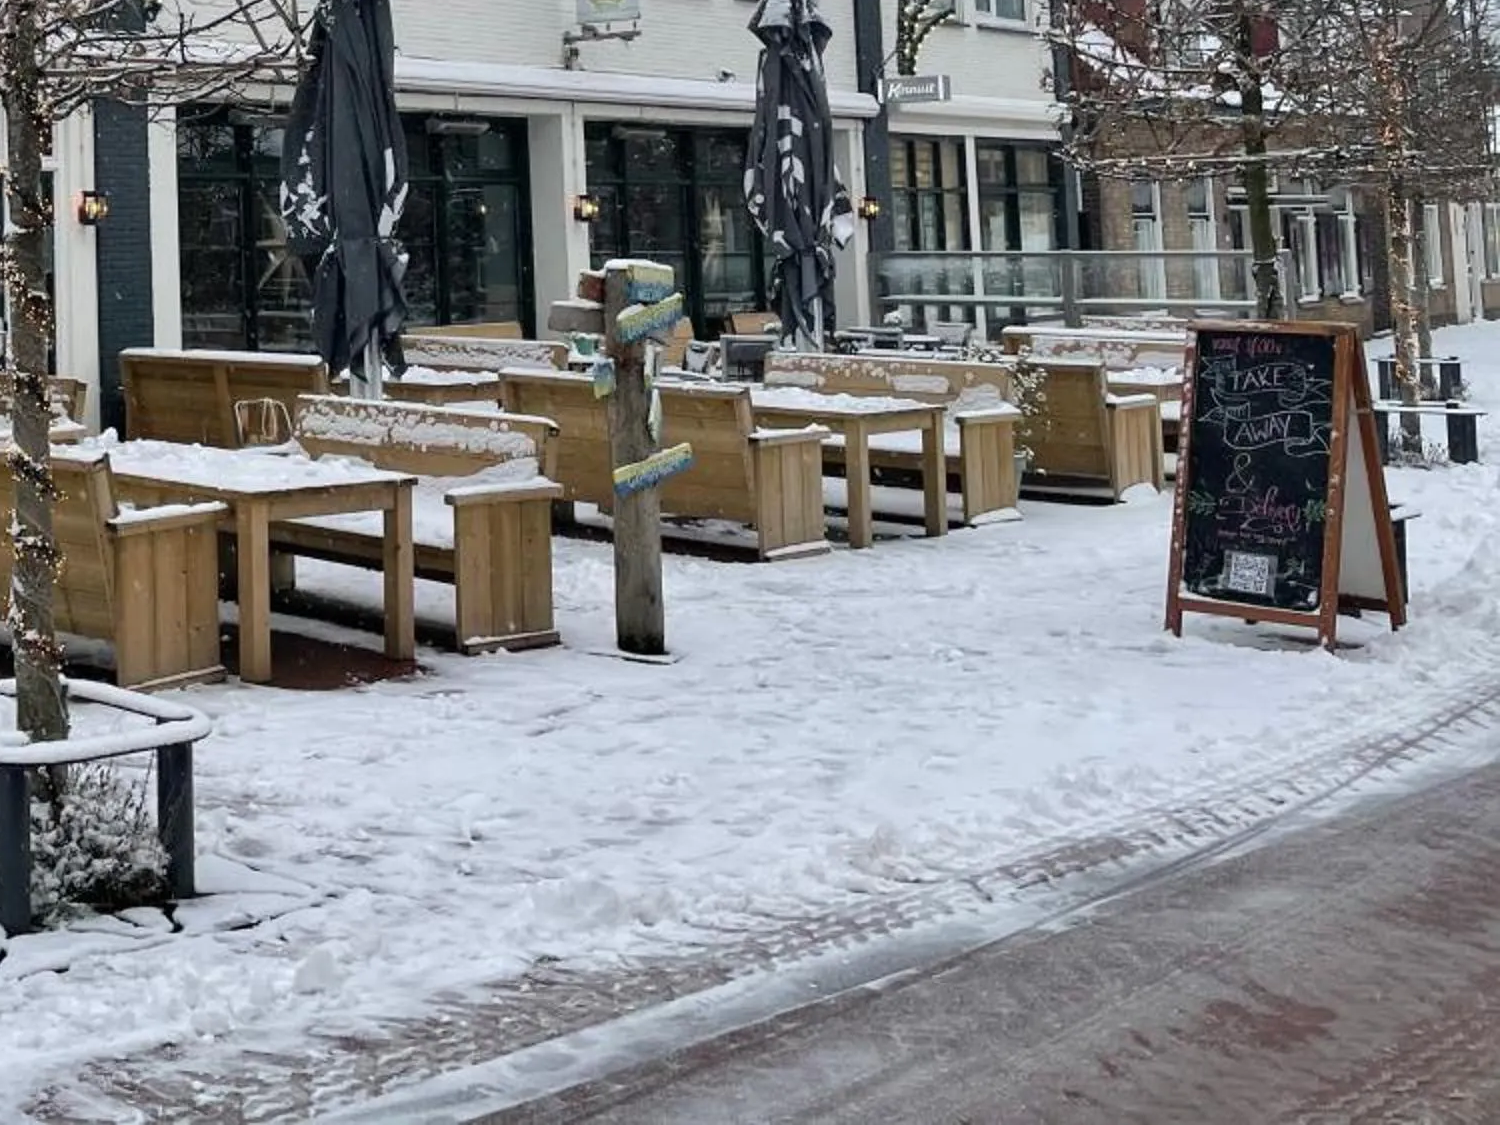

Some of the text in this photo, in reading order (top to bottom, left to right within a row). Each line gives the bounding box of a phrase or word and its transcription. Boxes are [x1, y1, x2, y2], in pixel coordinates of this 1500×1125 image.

[1227, 365, 1286, 391] TAKE
[1234, 414, 1292, 444] AWAY
[1225, 452, 1256, 494] &
